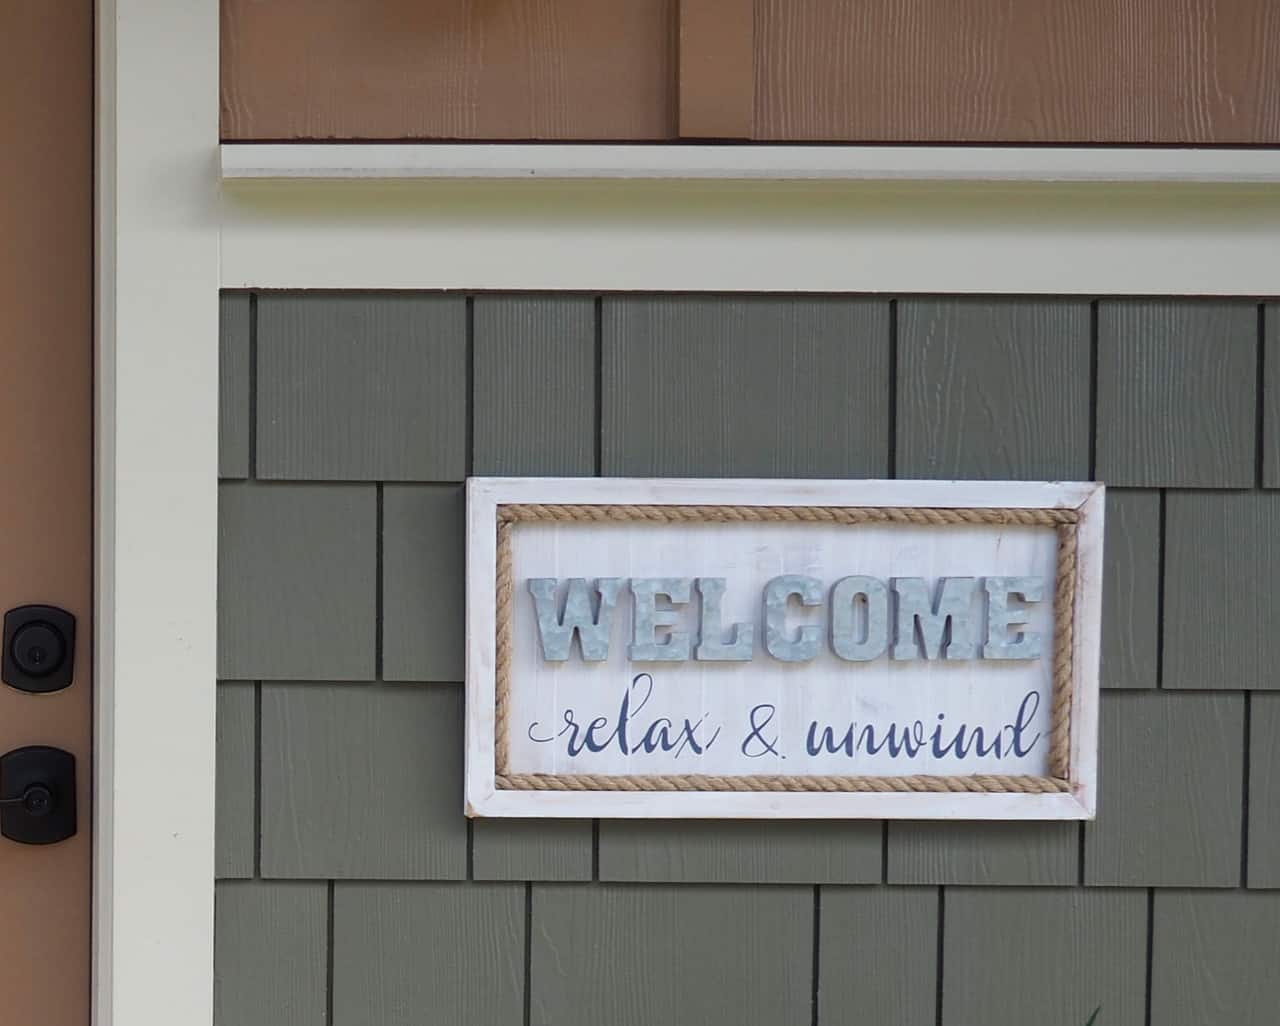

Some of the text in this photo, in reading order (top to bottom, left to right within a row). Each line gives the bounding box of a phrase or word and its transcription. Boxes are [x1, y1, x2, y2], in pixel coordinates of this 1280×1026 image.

[527, 575, 1045, 662] WELCOME
[528, 673, 1050, 759] relax & unwind
